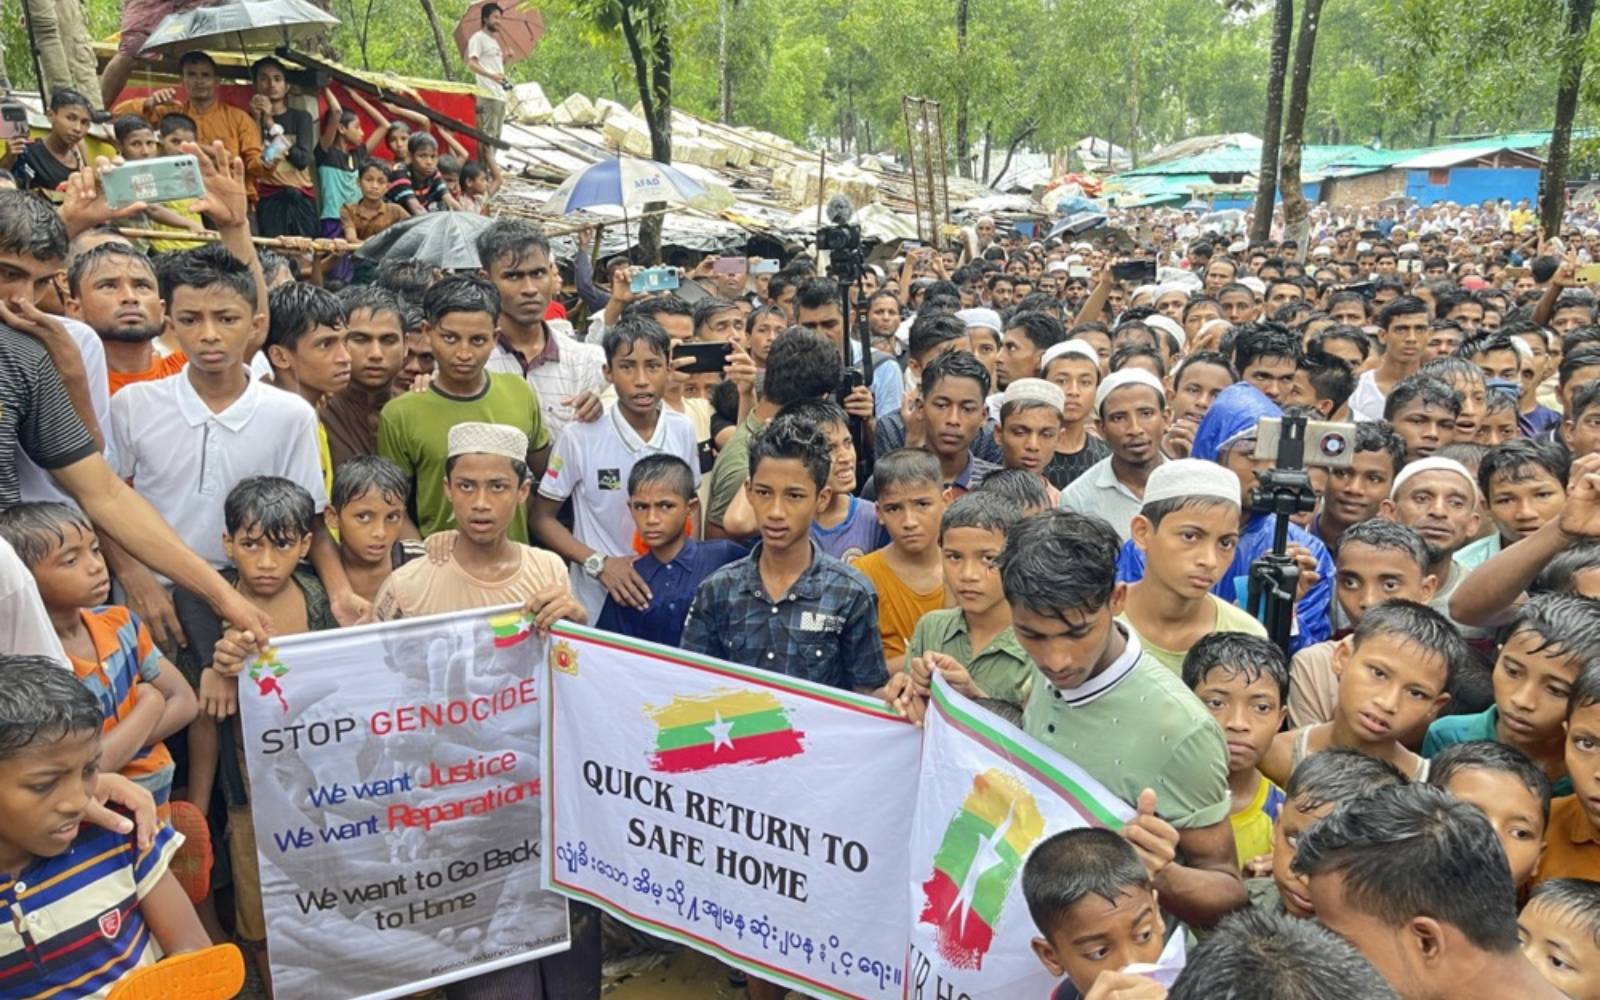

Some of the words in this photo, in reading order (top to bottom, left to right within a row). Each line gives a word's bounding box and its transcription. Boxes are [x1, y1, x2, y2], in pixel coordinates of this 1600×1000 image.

[261, 717, 356, 754] STOP
[370, 678, 537, 735] GENOCIDE
[308, 785, 346, 808] We
[352, 772, 412, 798] want
[419, 751, 517, 789] Justice
[582, 759, 675, 812] QUICK
[685, 790, 810, 856] RETURN
[822, 832, 870, 873] TO
[273, 827, 313, 852] We
[320, 815, 379, 842] want
[626, 817, 705, 867] SAFE
[715, 846, 809, 903] HOME
[295, 890, 338, 914] We
[343, 876, 407, 906] want
[416, 869, 442, 889] to
[447, 859, 479, 883] Go
[484, 840, 541, 869] Back
[375, 910, 403, 931] to
[408, 890, 477, 925] Home
